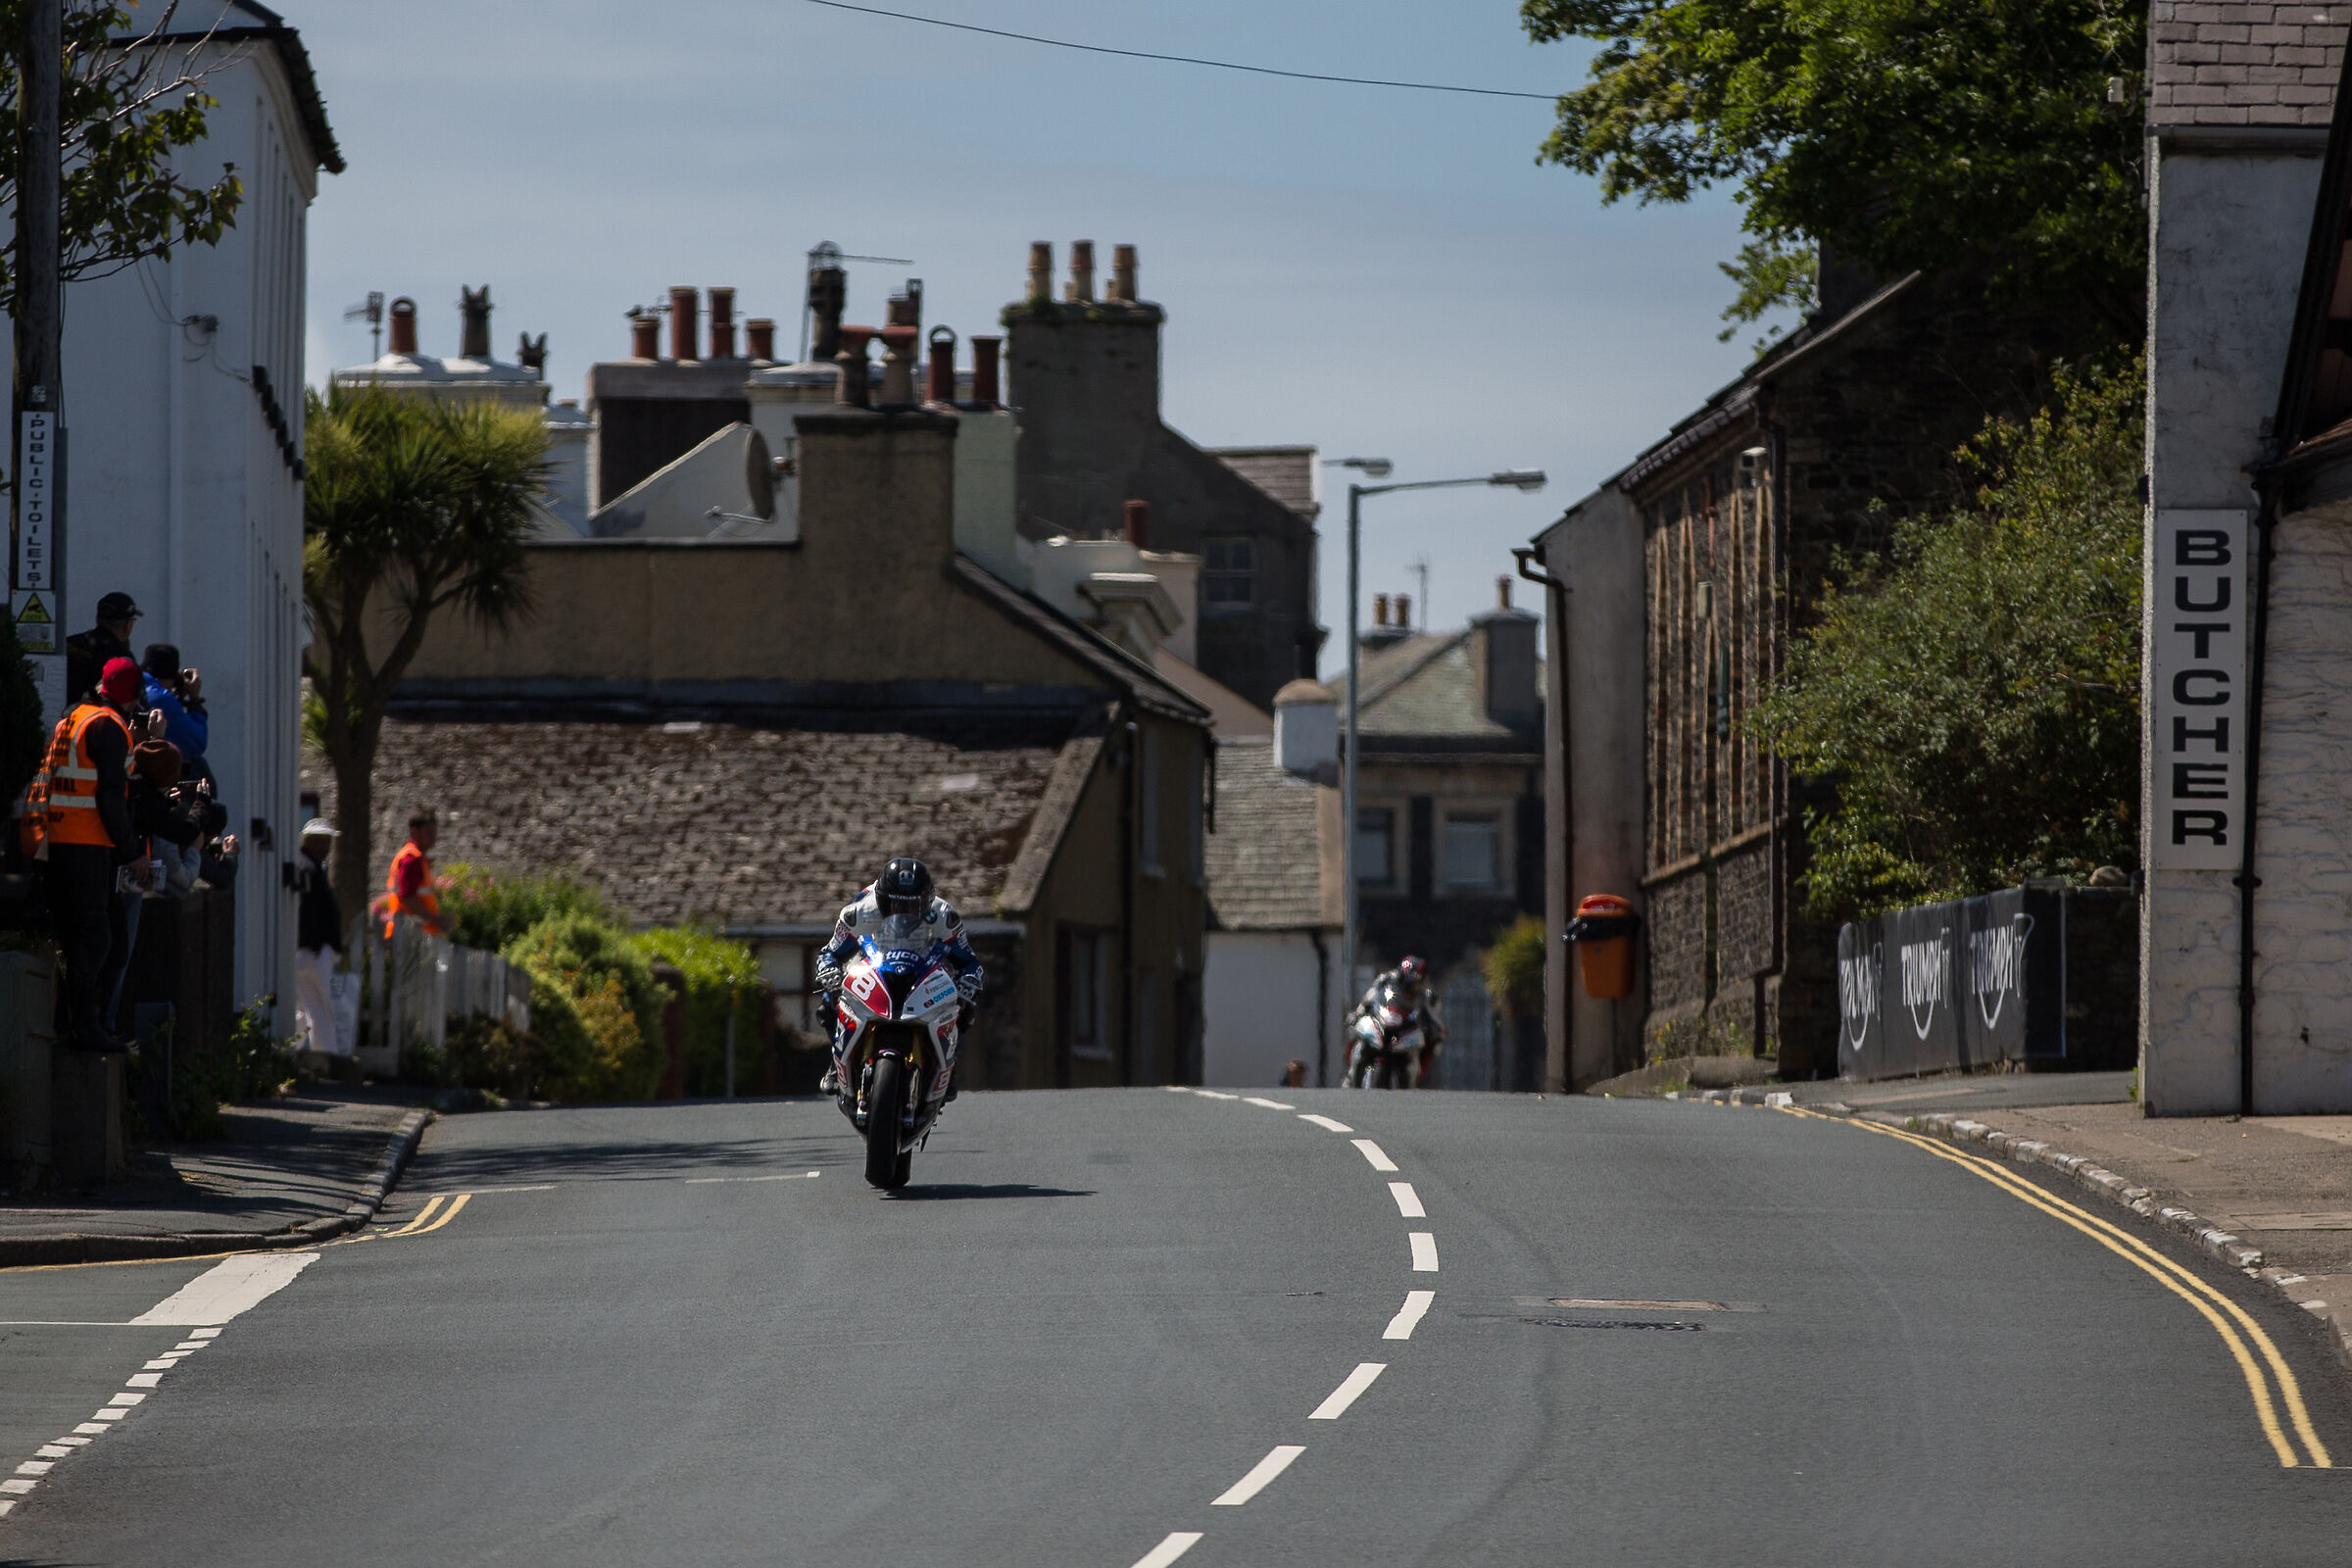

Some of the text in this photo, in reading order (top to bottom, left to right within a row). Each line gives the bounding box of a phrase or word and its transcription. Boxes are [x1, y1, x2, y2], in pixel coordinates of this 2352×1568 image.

[29, 418, 45, 488] PUBLIC
[26, 501, 42, 582] TOILETS
[2172, 529, 2231, 846] BUTCHER
[885, 950, 919, 961] tyco
[851, 971, 876, 1002] 8
[933, 987, 956, 1003] OXFORD
